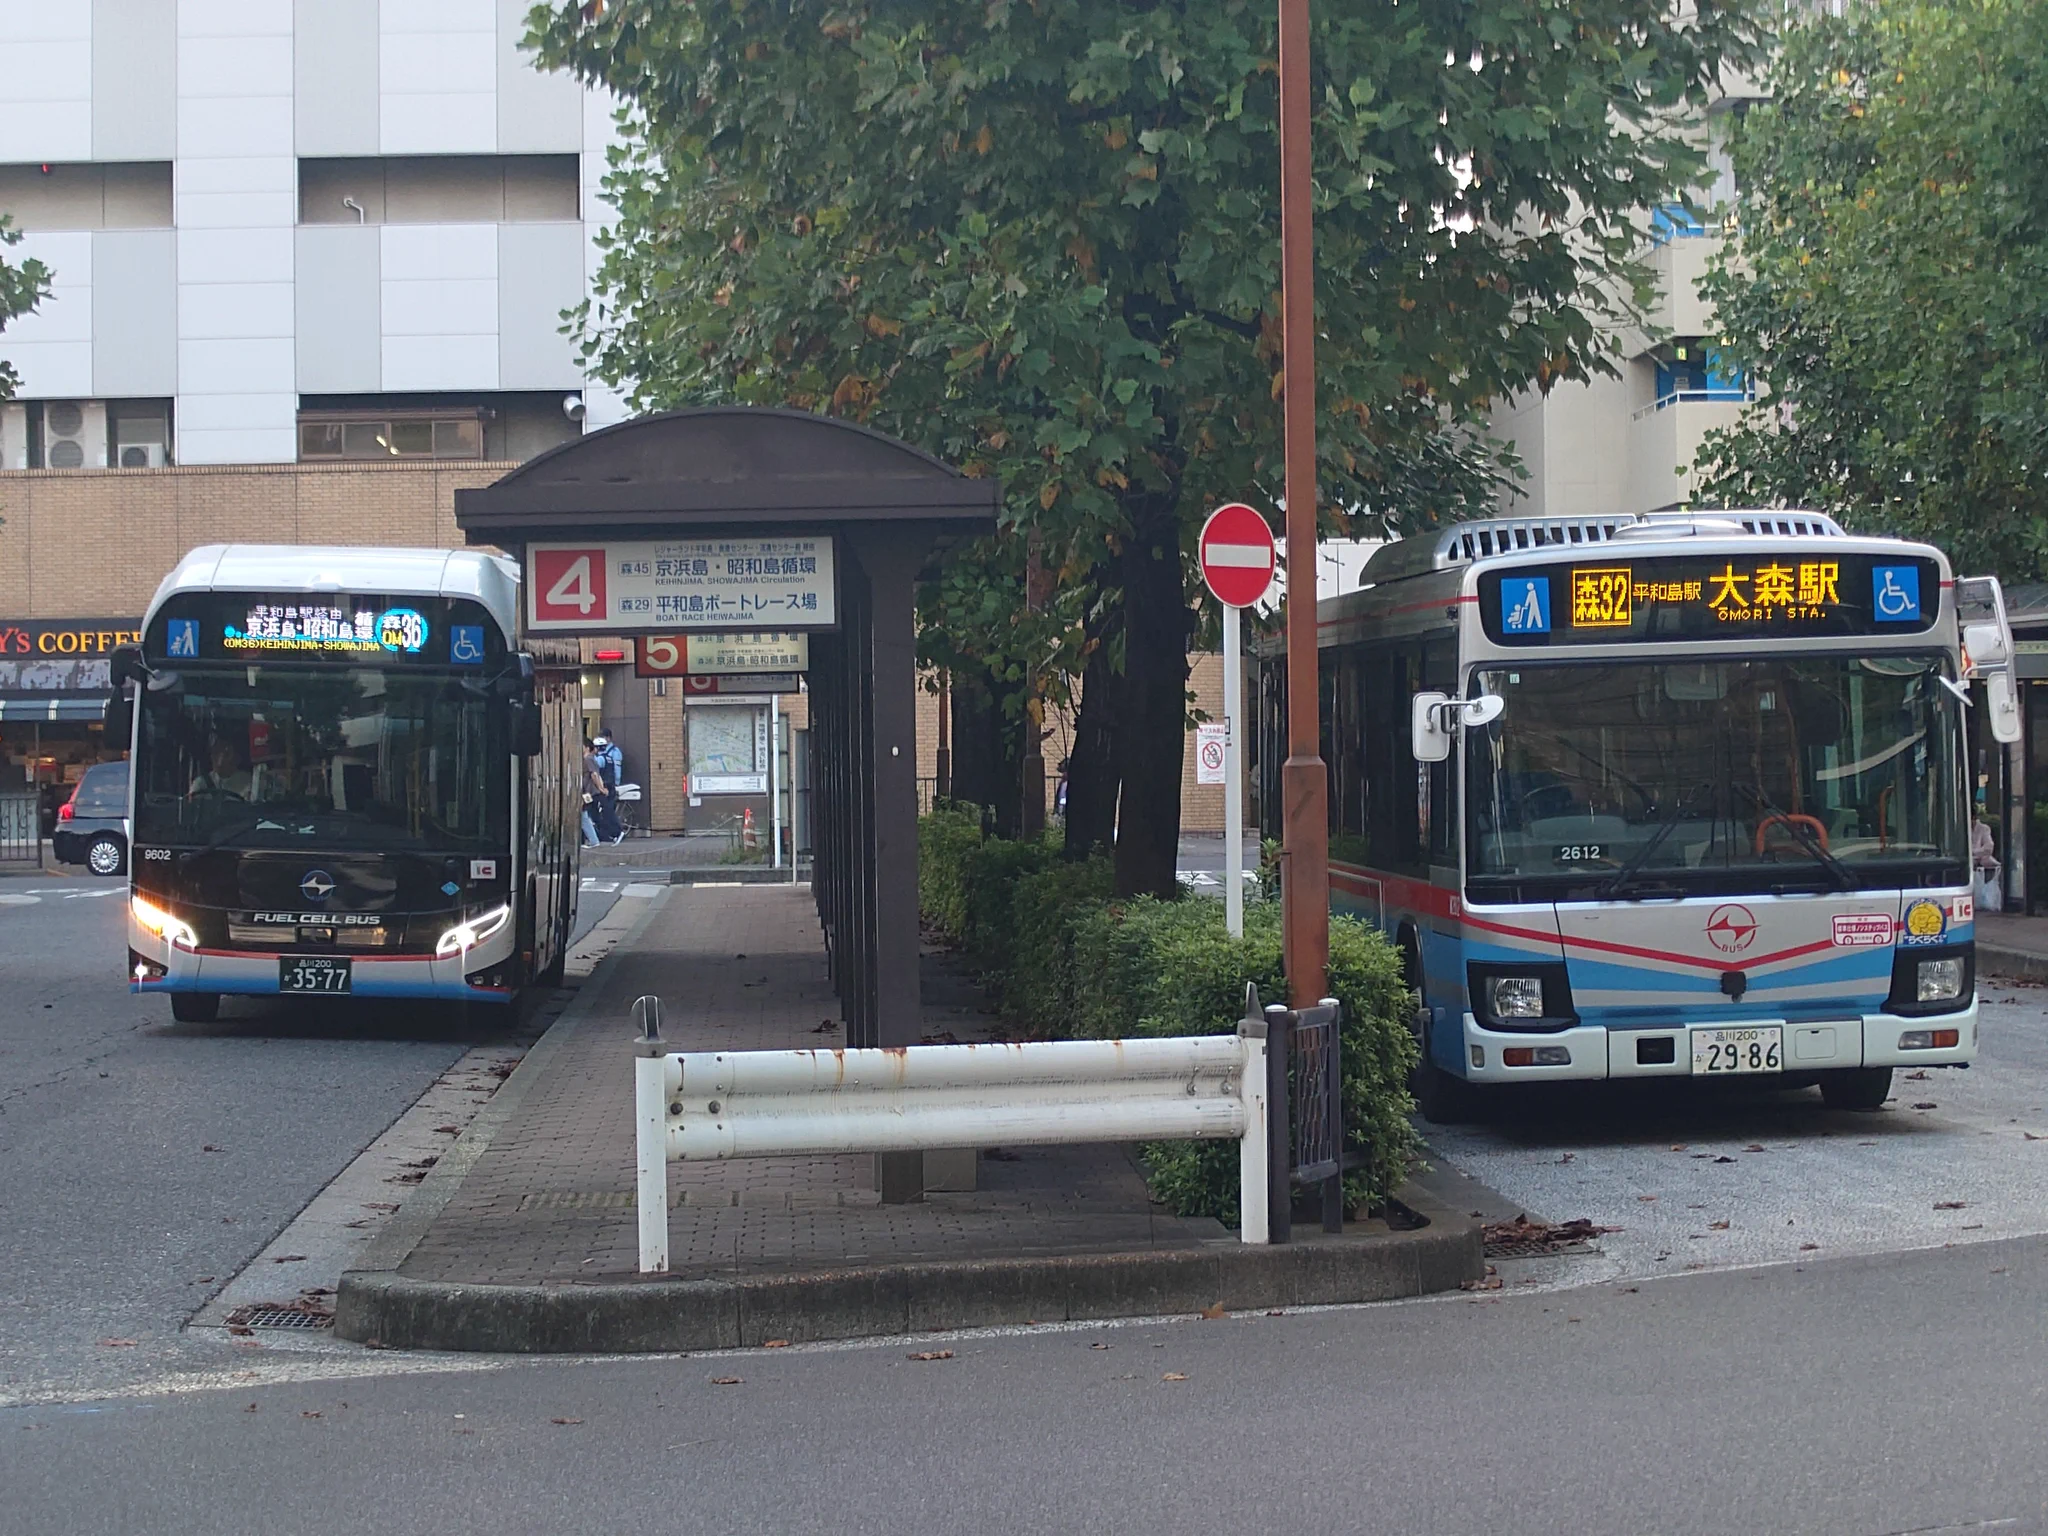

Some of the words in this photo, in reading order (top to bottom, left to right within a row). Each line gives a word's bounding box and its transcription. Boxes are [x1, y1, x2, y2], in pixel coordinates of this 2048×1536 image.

[621, 563, 649, 574] 森45
[655, 557, 816, 576] 京浜島・昭和島循環
[546, 556, 596, 614] 4
[707, 577, 758, 585] SHOWAJIMA
[760, 576, 805, 584] Circulation
[1576, 575, 1628, 621] 森32
[1632, 582, 1702, 602] 平和島駅
[1708, 562, 1840, 609] 大森駅
[621, 600, 649, 611] 森29
[656, 593, 817, 613] 平和島ボートレース場
[254, 605, 343, 620] 平和島駅経由
[656, 614, 679, 622] BOAT
[706, 613, 754, 621] HEIWAJIMA
[1787, 606, 1827, 620] STA.
[646, 635, 679, 670] 5
[145, 849, 171, 860] 9602
[1561, 846, 1600, 860] 2612
[253, 913, 297, 923] FUEL
[299, 914, 342, 924] CELL
[344, 915, 380, 925] BUS
[1721, 943, 1744, 953] BUS
[293, 968, 347, 989] 35-77
[1707, 1042, 1779, 1071] 29-86
